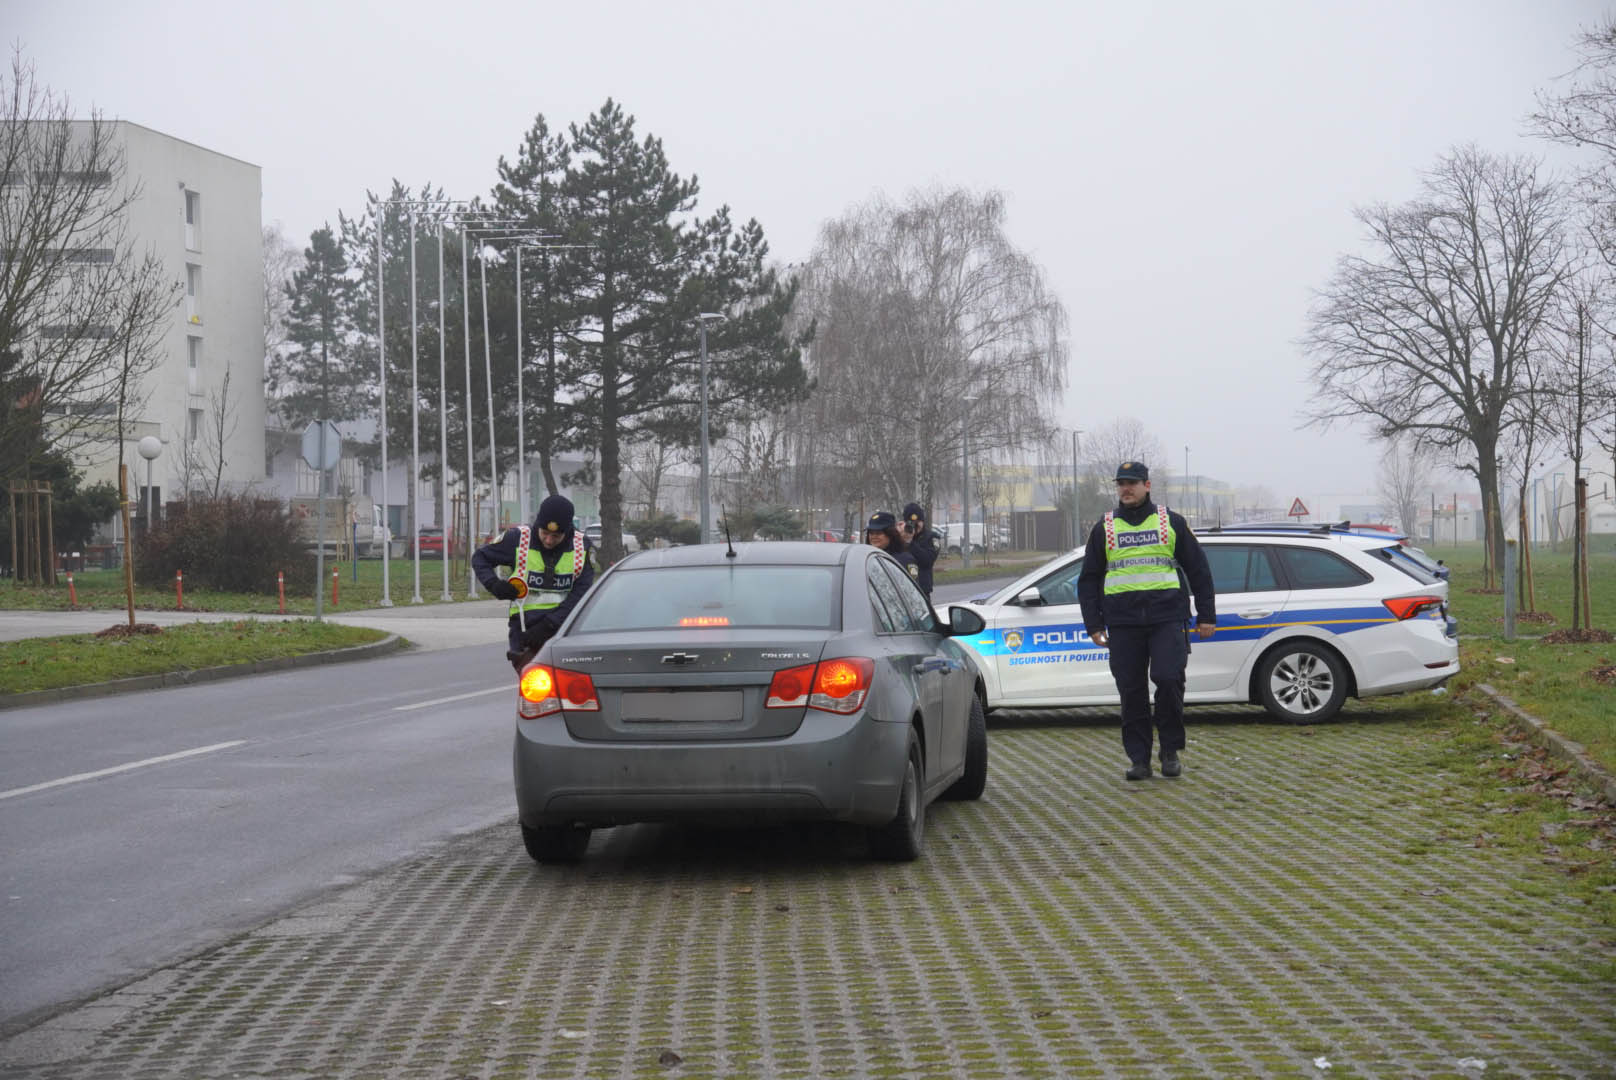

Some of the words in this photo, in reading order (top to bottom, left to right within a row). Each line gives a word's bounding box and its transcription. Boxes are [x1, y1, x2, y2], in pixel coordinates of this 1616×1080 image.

[528, 575, 571, 587] POIJA
[1033, 630, 1093, 645] POLIC
[1009, 655, 1061, 666] SIGURNOST
[1063, 655, 1067, 663] I
[1069, 652, 1110, 663] POVJERE
